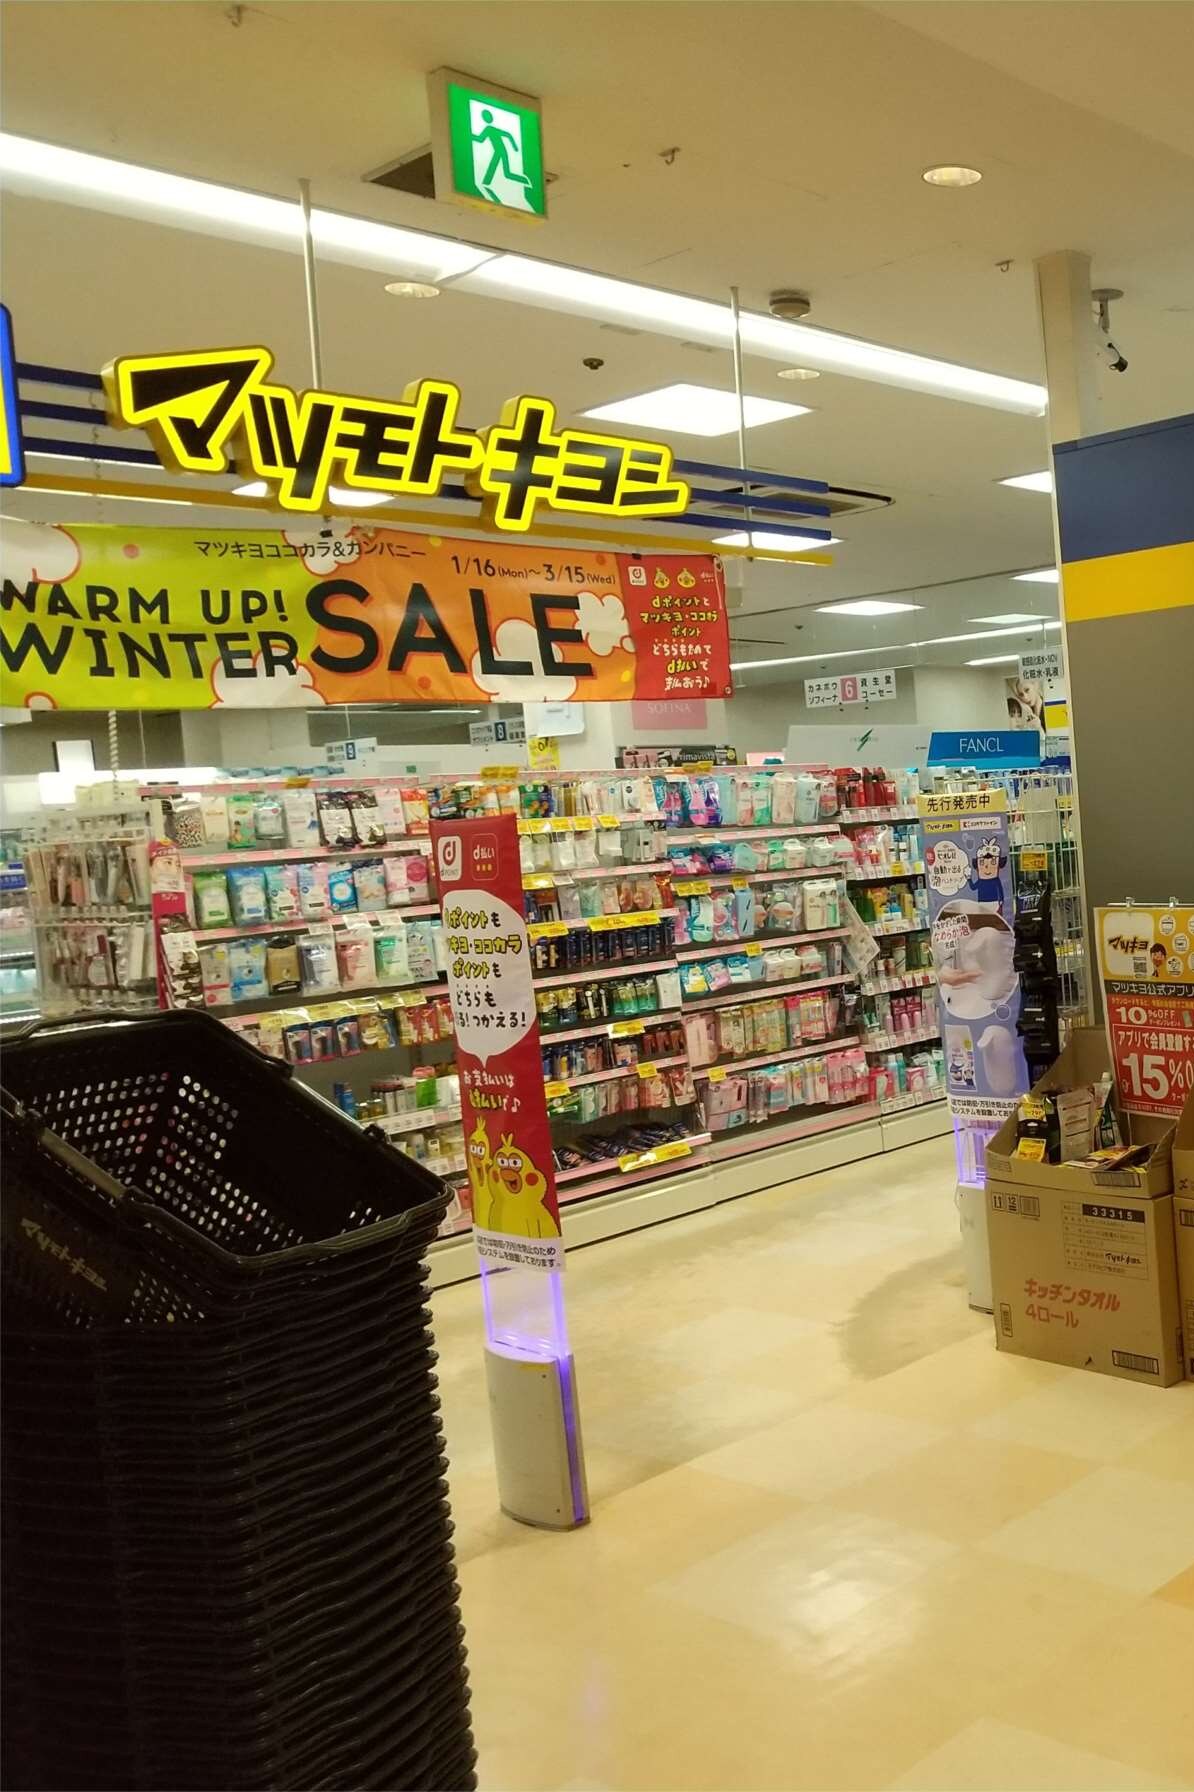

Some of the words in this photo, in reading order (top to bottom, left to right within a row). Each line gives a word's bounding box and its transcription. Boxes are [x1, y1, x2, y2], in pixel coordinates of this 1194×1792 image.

[120, 352, 687, 526] マツモトキヨシ
[194, 540, 426, 559] マツキヨココカラ&カンパニー
[201, 589, 289, 625] UP!
[305, 578, 594, 676] SALE
[671, 625, 702, 637] ポイント
[0, 622, 299, 679] WINTER
[807, 682, 838, 693] カネボウ
[844, 681, 854, 697] 6
[861, 688, 893, 699] コーセー
[807, 694, 839, 705] ソフィーナ
[959, 737, 1004, 753] FANCL
[927, 793, 991, 812] 先行発売中
[1108, 937, 1149, 954] マツキヨ
[1111, 982, 1194, 997] マツキヨ公式アプリ
[456, 1011, 527, 1029] る!つかえる!
[1091, 1206, 1134, 1221] 33315
[1024, 1278, 1121, 1313] キッチンタオル
[1025, 1306, 1079, 1329] 4ロール
